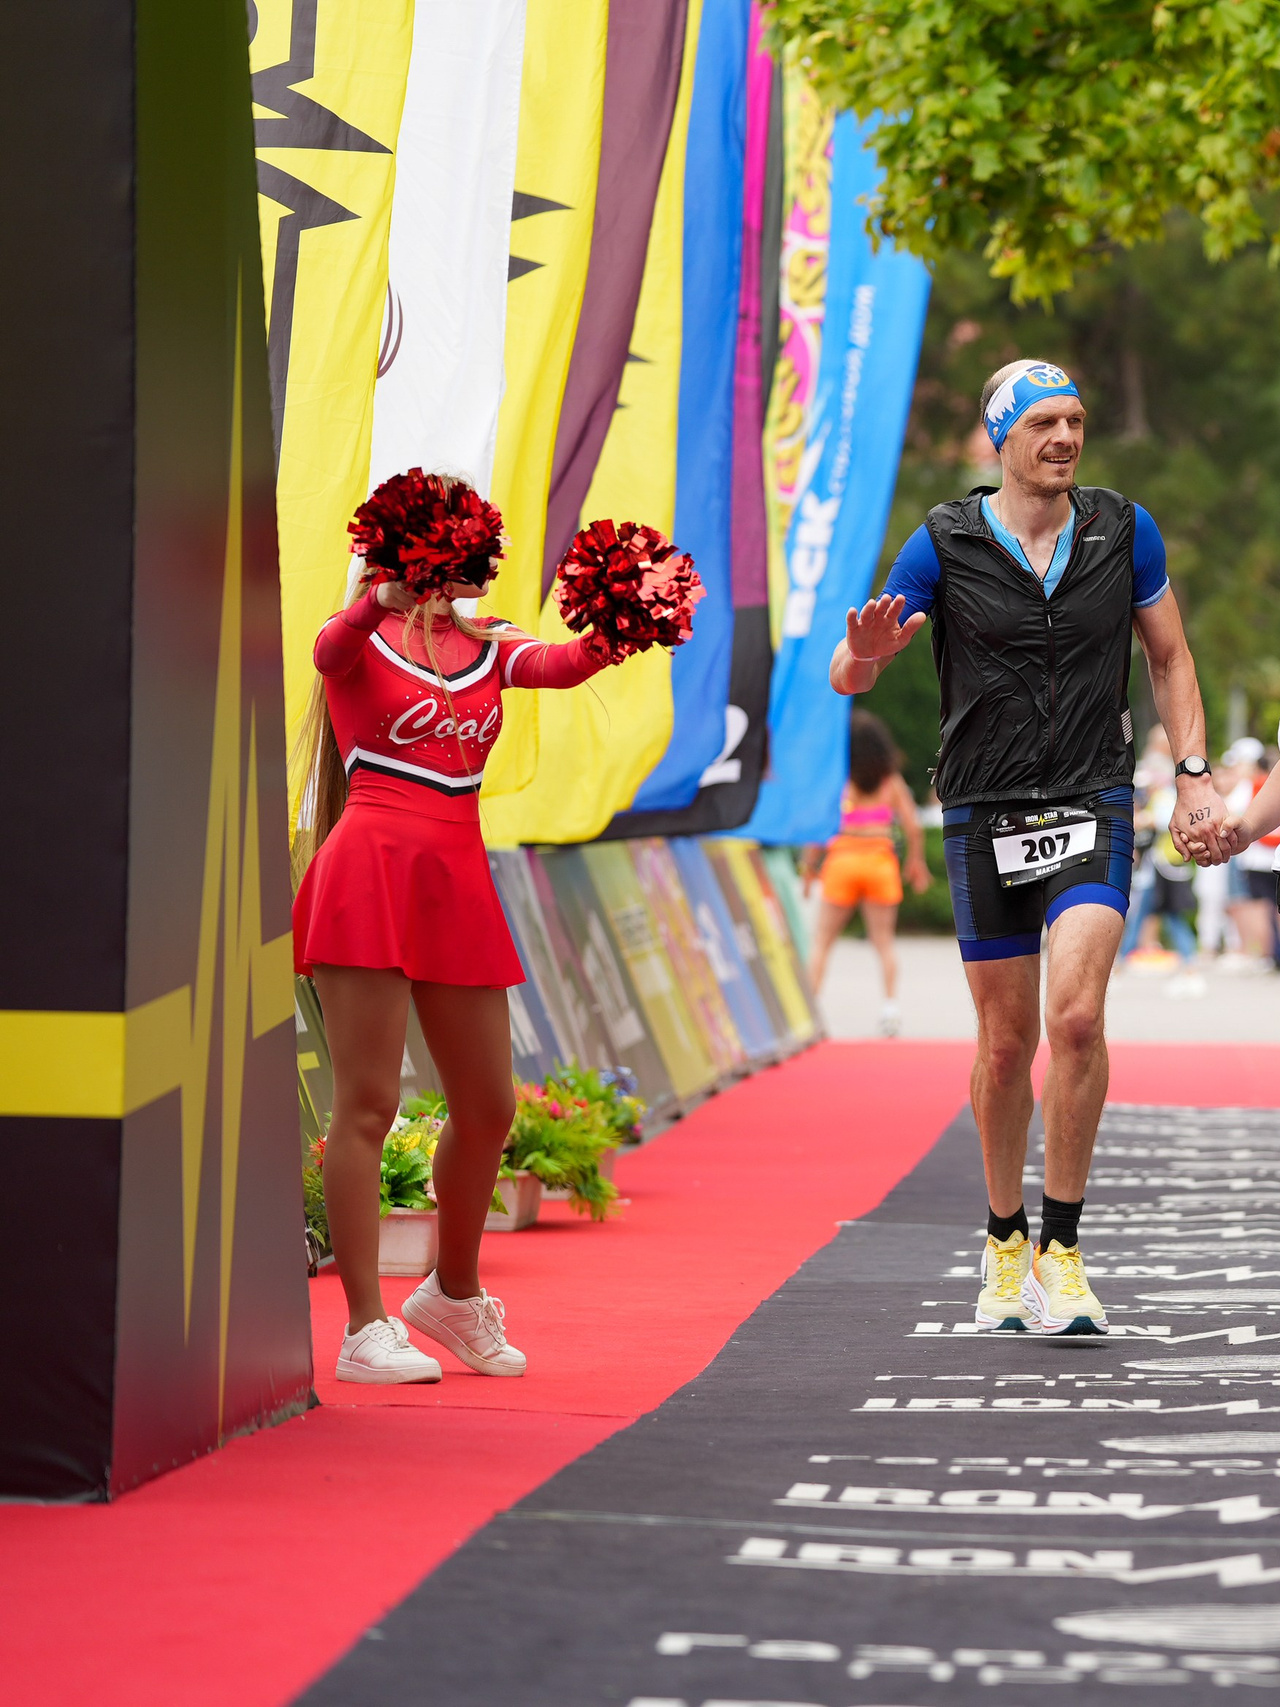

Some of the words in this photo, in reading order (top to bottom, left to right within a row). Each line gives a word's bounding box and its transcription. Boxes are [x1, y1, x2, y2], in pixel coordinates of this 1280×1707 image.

[388, 698, 498, 745] Cool
[1025, 814, 1039, 823] IRON
[1043, 811, 1058, 820] STAR
[1188, 807, 1211, 826] 207
[1021, 832, 1070, 863] 207
[1035, 862, 1061, 876] MAKSIM
[861, 1398, 1162, 1408] IRON
[786, 1482, 1143, 1508] IRON
[737, 1537, 1133, 1570] IRON
